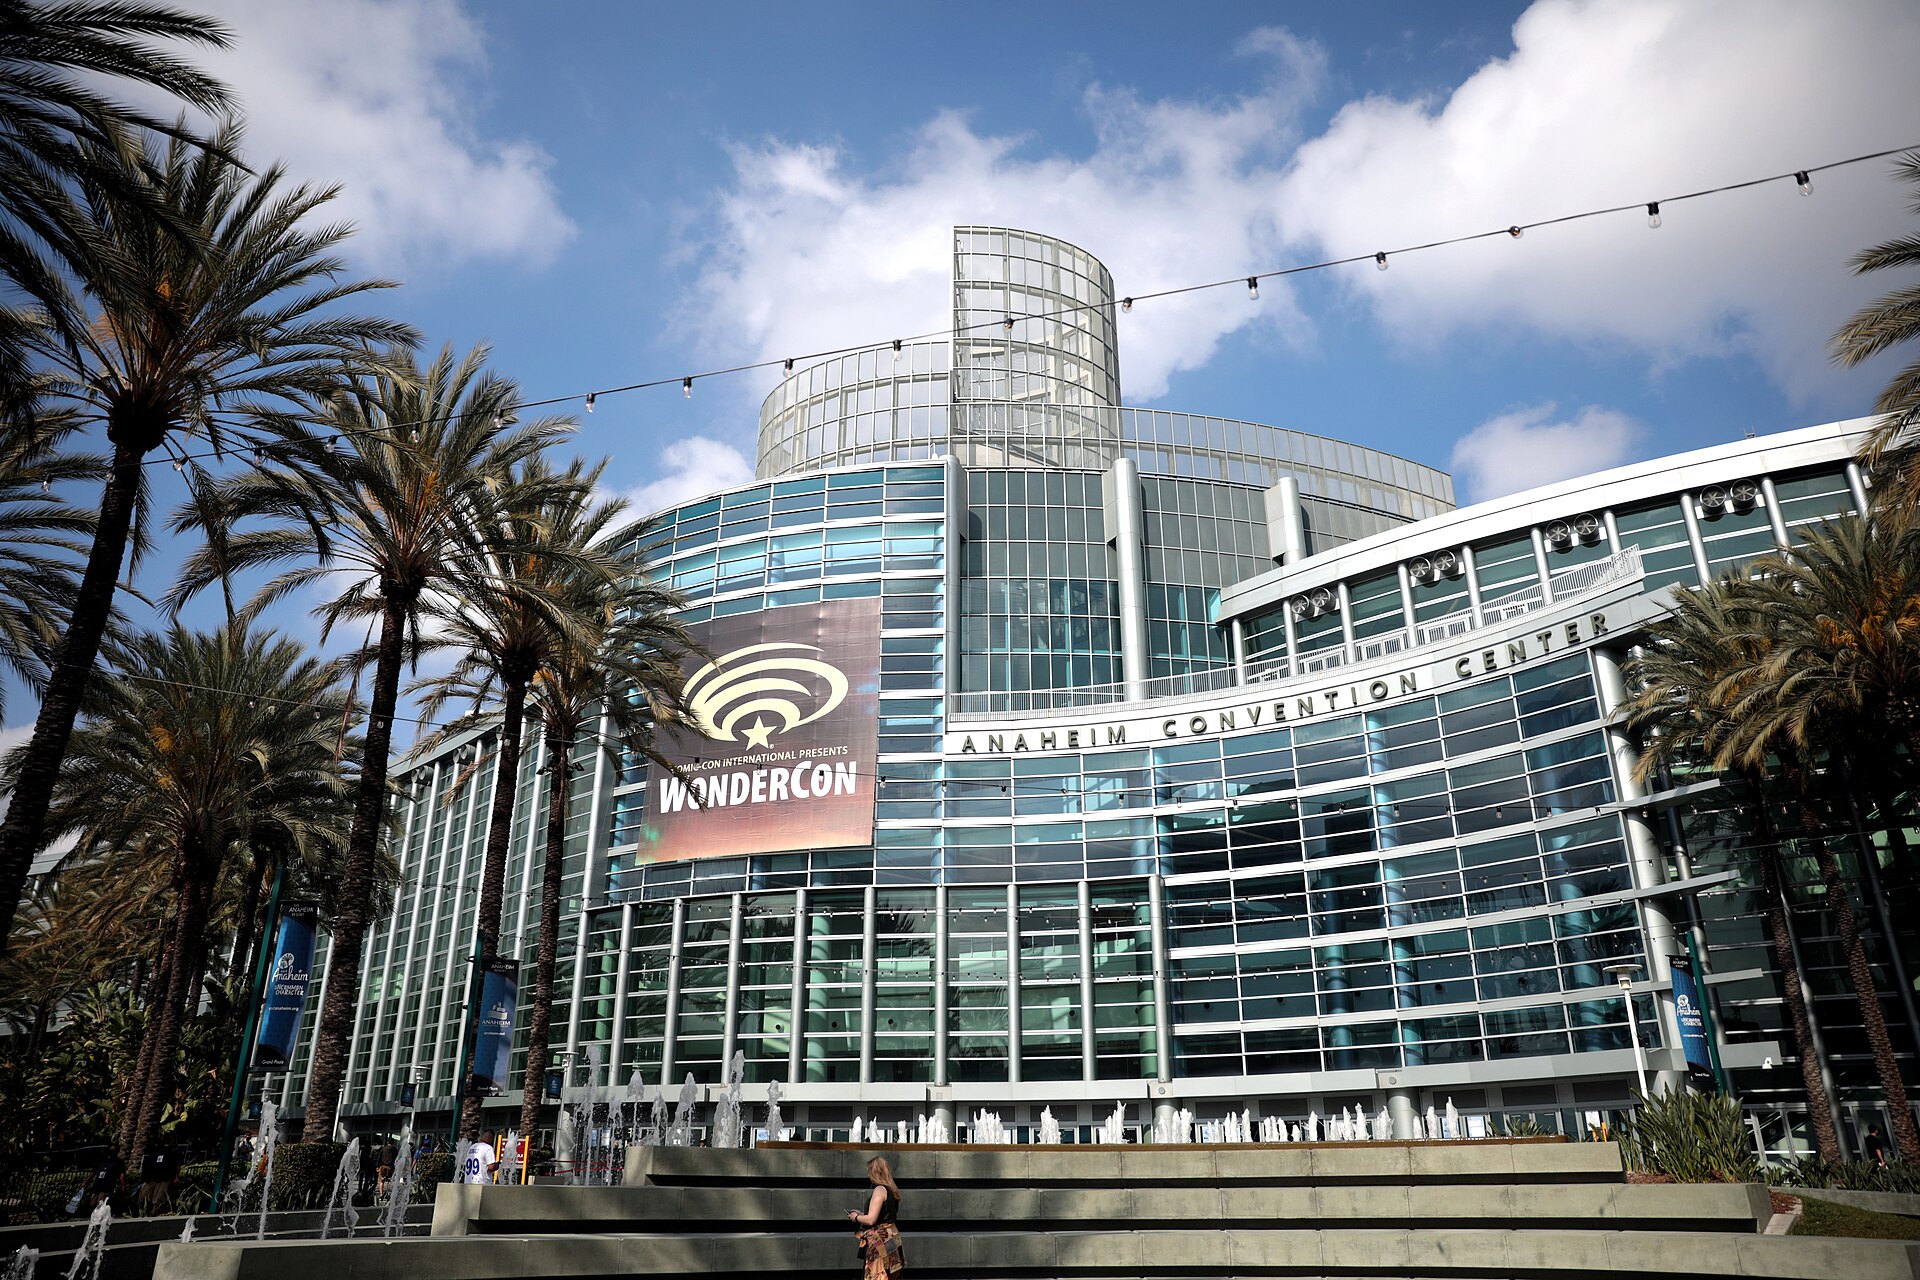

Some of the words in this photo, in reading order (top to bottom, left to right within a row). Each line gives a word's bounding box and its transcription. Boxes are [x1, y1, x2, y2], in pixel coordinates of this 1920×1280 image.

[962, 725, 1126, 753] ANAHEIM
[1163, 672, 1418, 736] CONVENTION
[1455, 612, 1609, 677] CENTER
[671, 759, 721, 774] OMIC-CON
[722, 751, 797, 768] INTERNATIONAL
[799, 746, 848, 759] PRESENTS
[271, 964, 309, 983] Anaheim
[465, 1157, 480, 1176] 99
